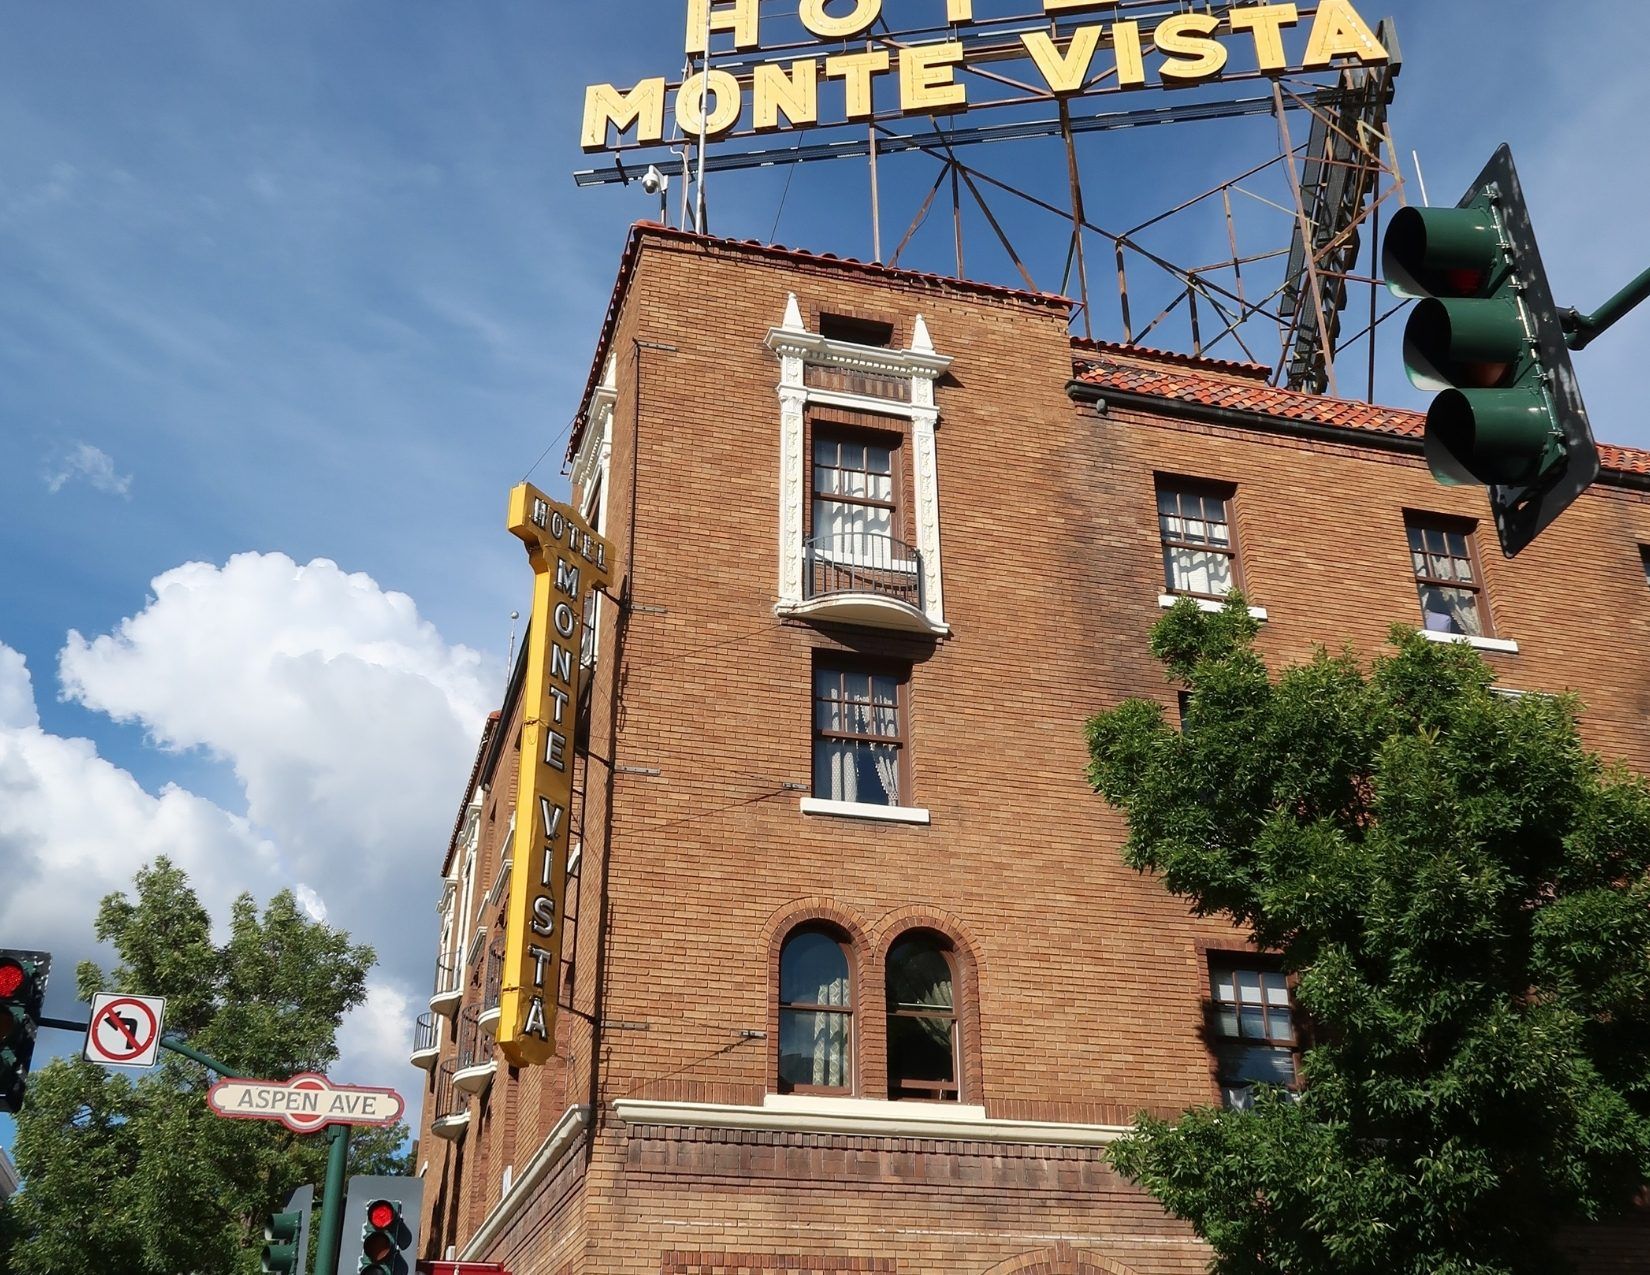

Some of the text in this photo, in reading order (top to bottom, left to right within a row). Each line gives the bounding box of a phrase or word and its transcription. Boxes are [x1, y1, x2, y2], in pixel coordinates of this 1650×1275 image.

[581, 0, 1389, 150] MONTE VISTA
[531, 496, 608, 574] HOTEL
[525, 557, 580, 1042] MONTE VISTA
[237, 1088, 378, 1115] ASPEN AVE
